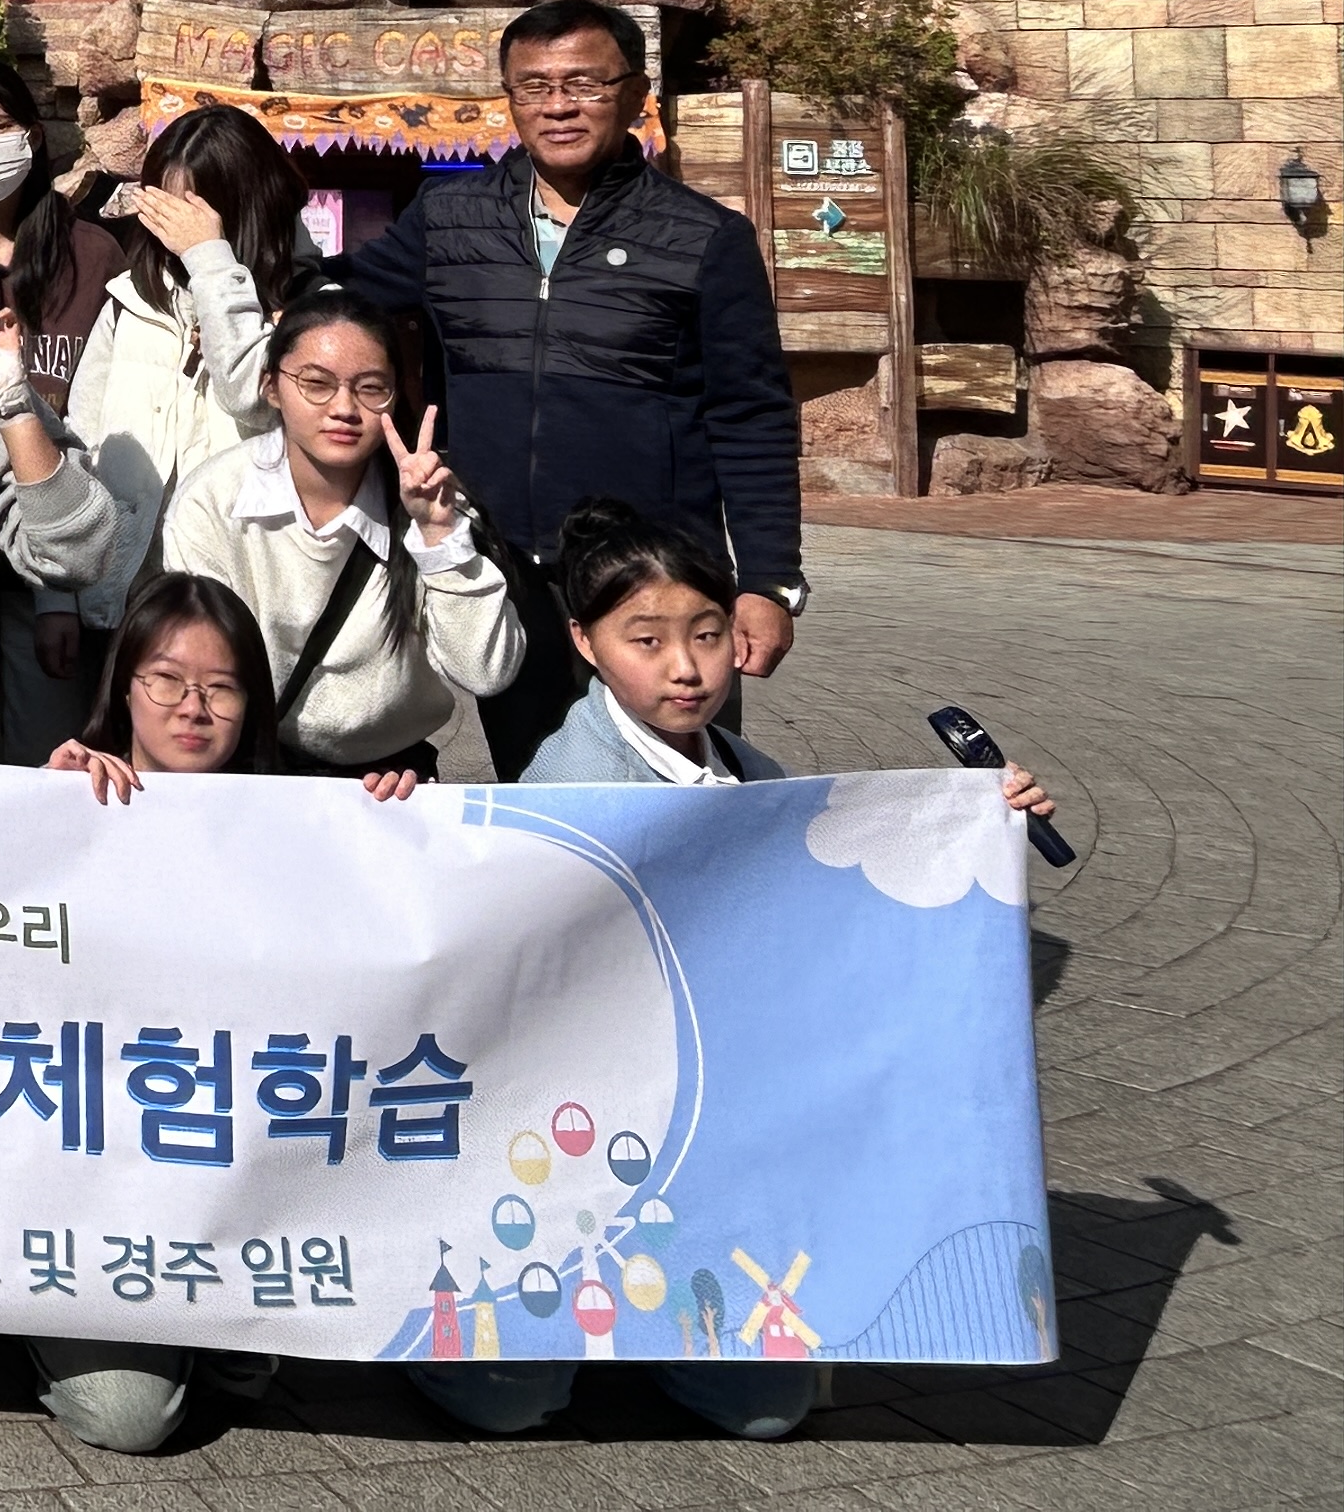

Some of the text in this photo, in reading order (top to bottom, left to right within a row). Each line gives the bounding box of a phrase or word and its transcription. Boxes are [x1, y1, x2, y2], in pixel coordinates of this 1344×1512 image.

[175, 22, 352, 74] MAGIC
[23, 1228, 78, 1298] 및
[101, 1234, 223, 1305] 경주
[240, 1235, 356, 1308] 일원
